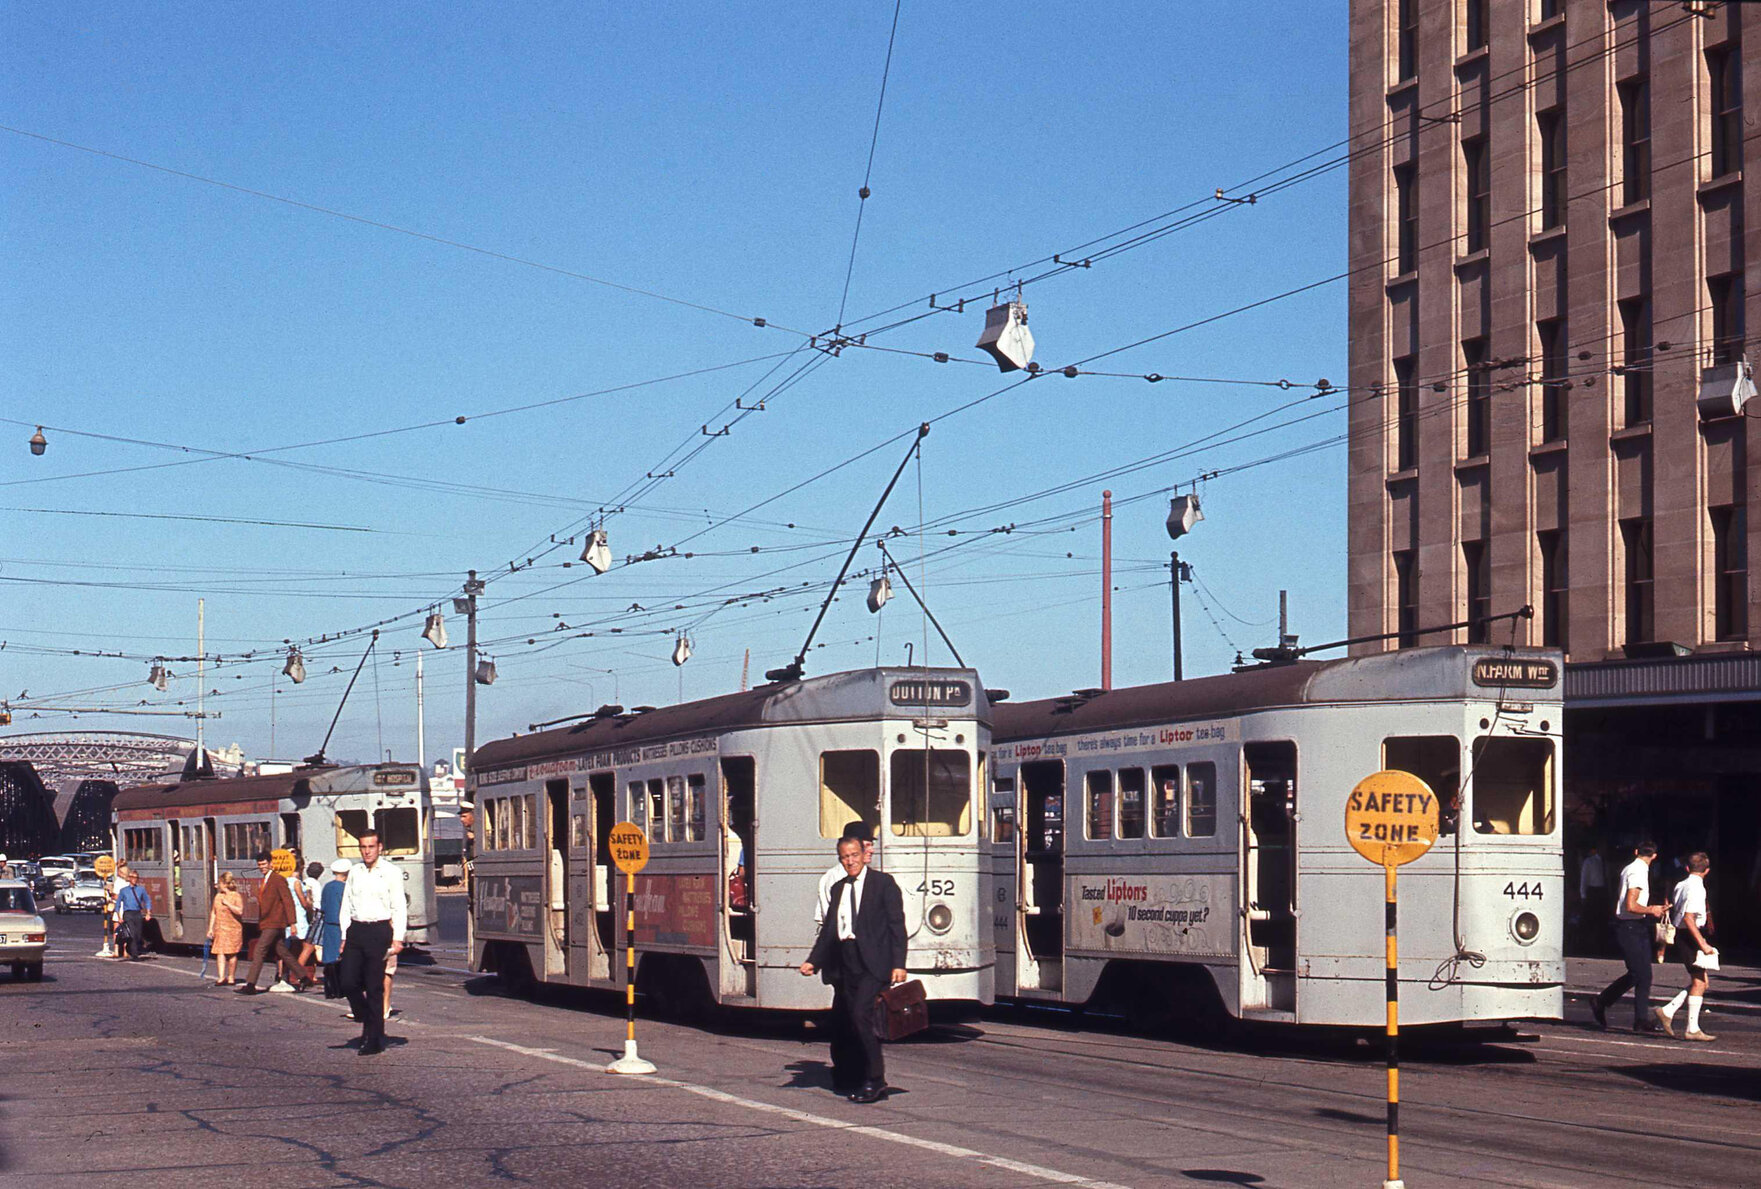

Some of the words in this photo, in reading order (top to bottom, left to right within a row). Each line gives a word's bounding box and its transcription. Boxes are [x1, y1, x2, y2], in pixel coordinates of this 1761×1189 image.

[1123, 734, 1138, 747] time
[1139, 732, 1150, 745] for
[1015, 744, 1041, 759] Lipton
[1351, 791, 1432, 815] SAFETY
[610, 833, 643, 845] SAFETY
[1360, 823, 1419, 842] ZONE
[616, 848, 641, 860] ZONE
[916, 880, 955, 896] 452
[1082, 885, 1106, 900] Tasted
[1503, 881, 1544, 900] 444
[1137, 906, 1164, 921] second
[1165, 910, 1188, 926] cuppa
